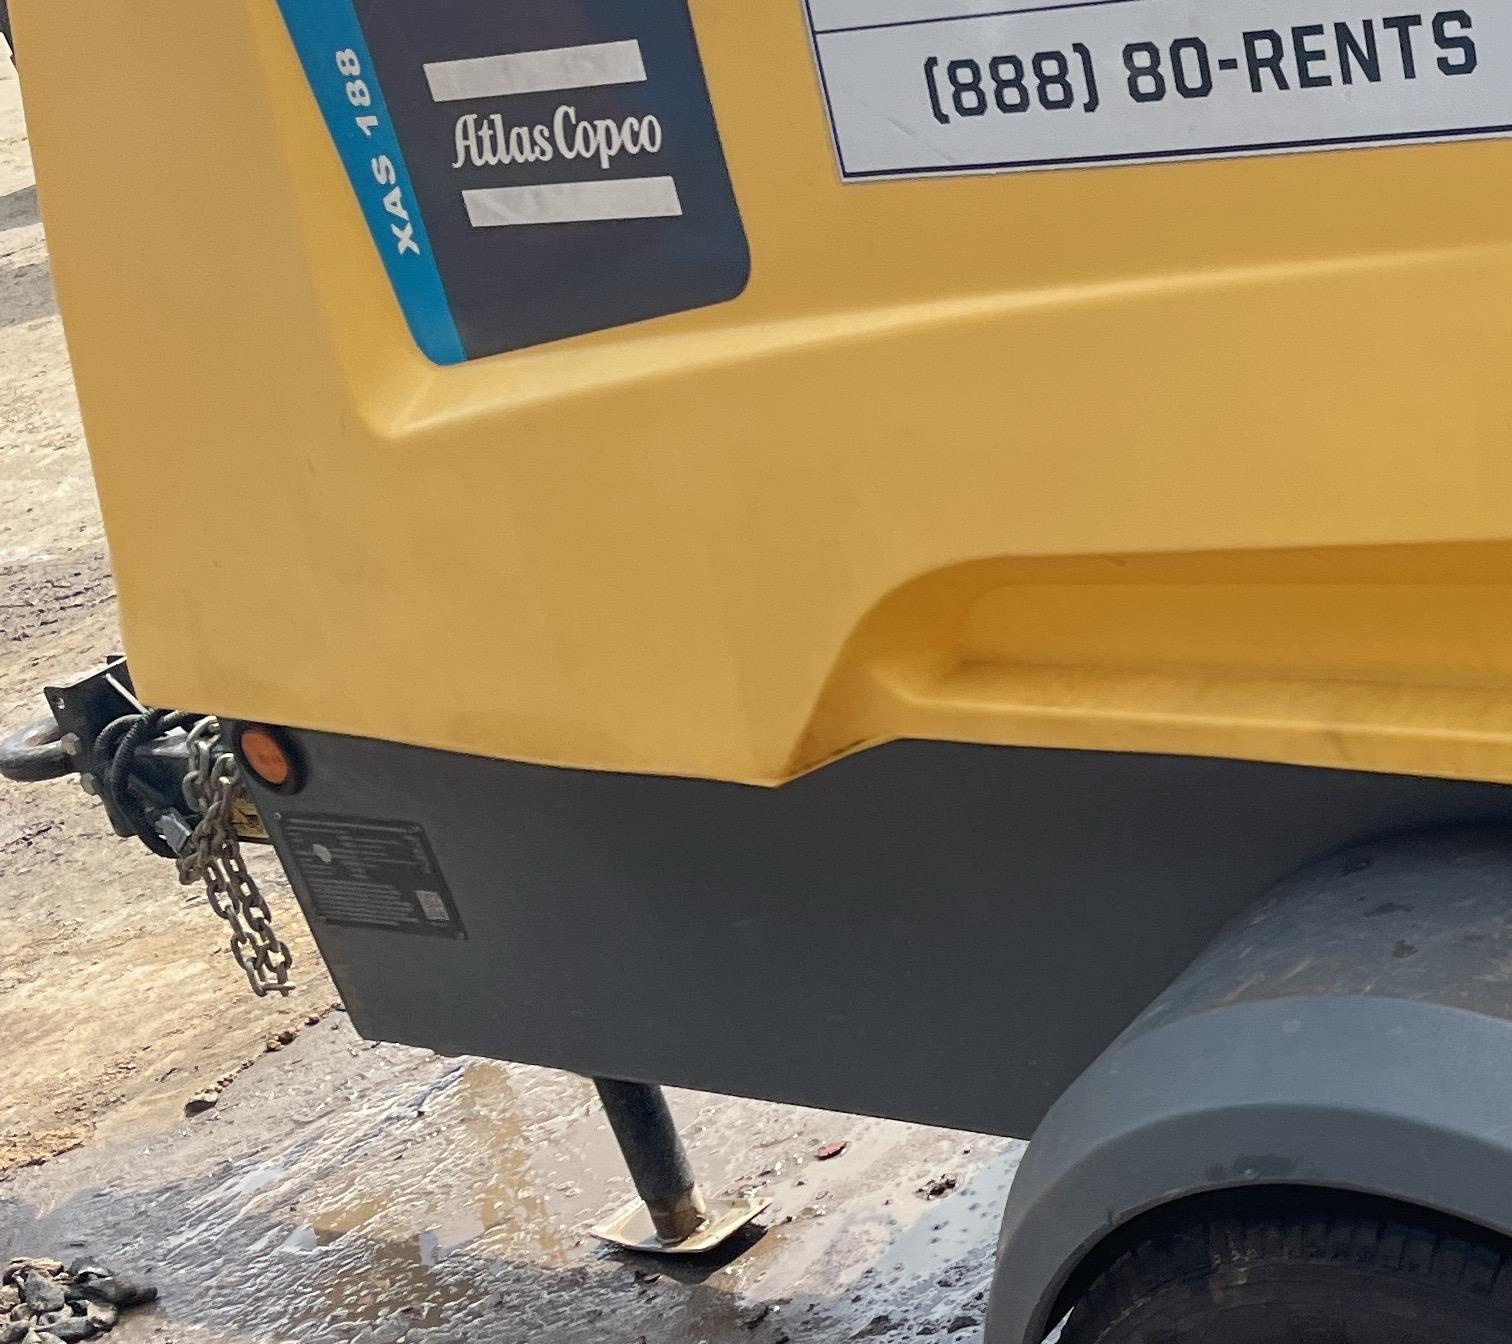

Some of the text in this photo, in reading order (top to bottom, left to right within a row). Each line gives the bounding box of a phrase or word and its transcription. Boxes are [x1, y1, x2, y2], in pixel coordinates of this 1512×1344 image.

[924, 9, 1478, 125] (888) 80-RENTS
[335, 47, 420, 255] XAS 188
